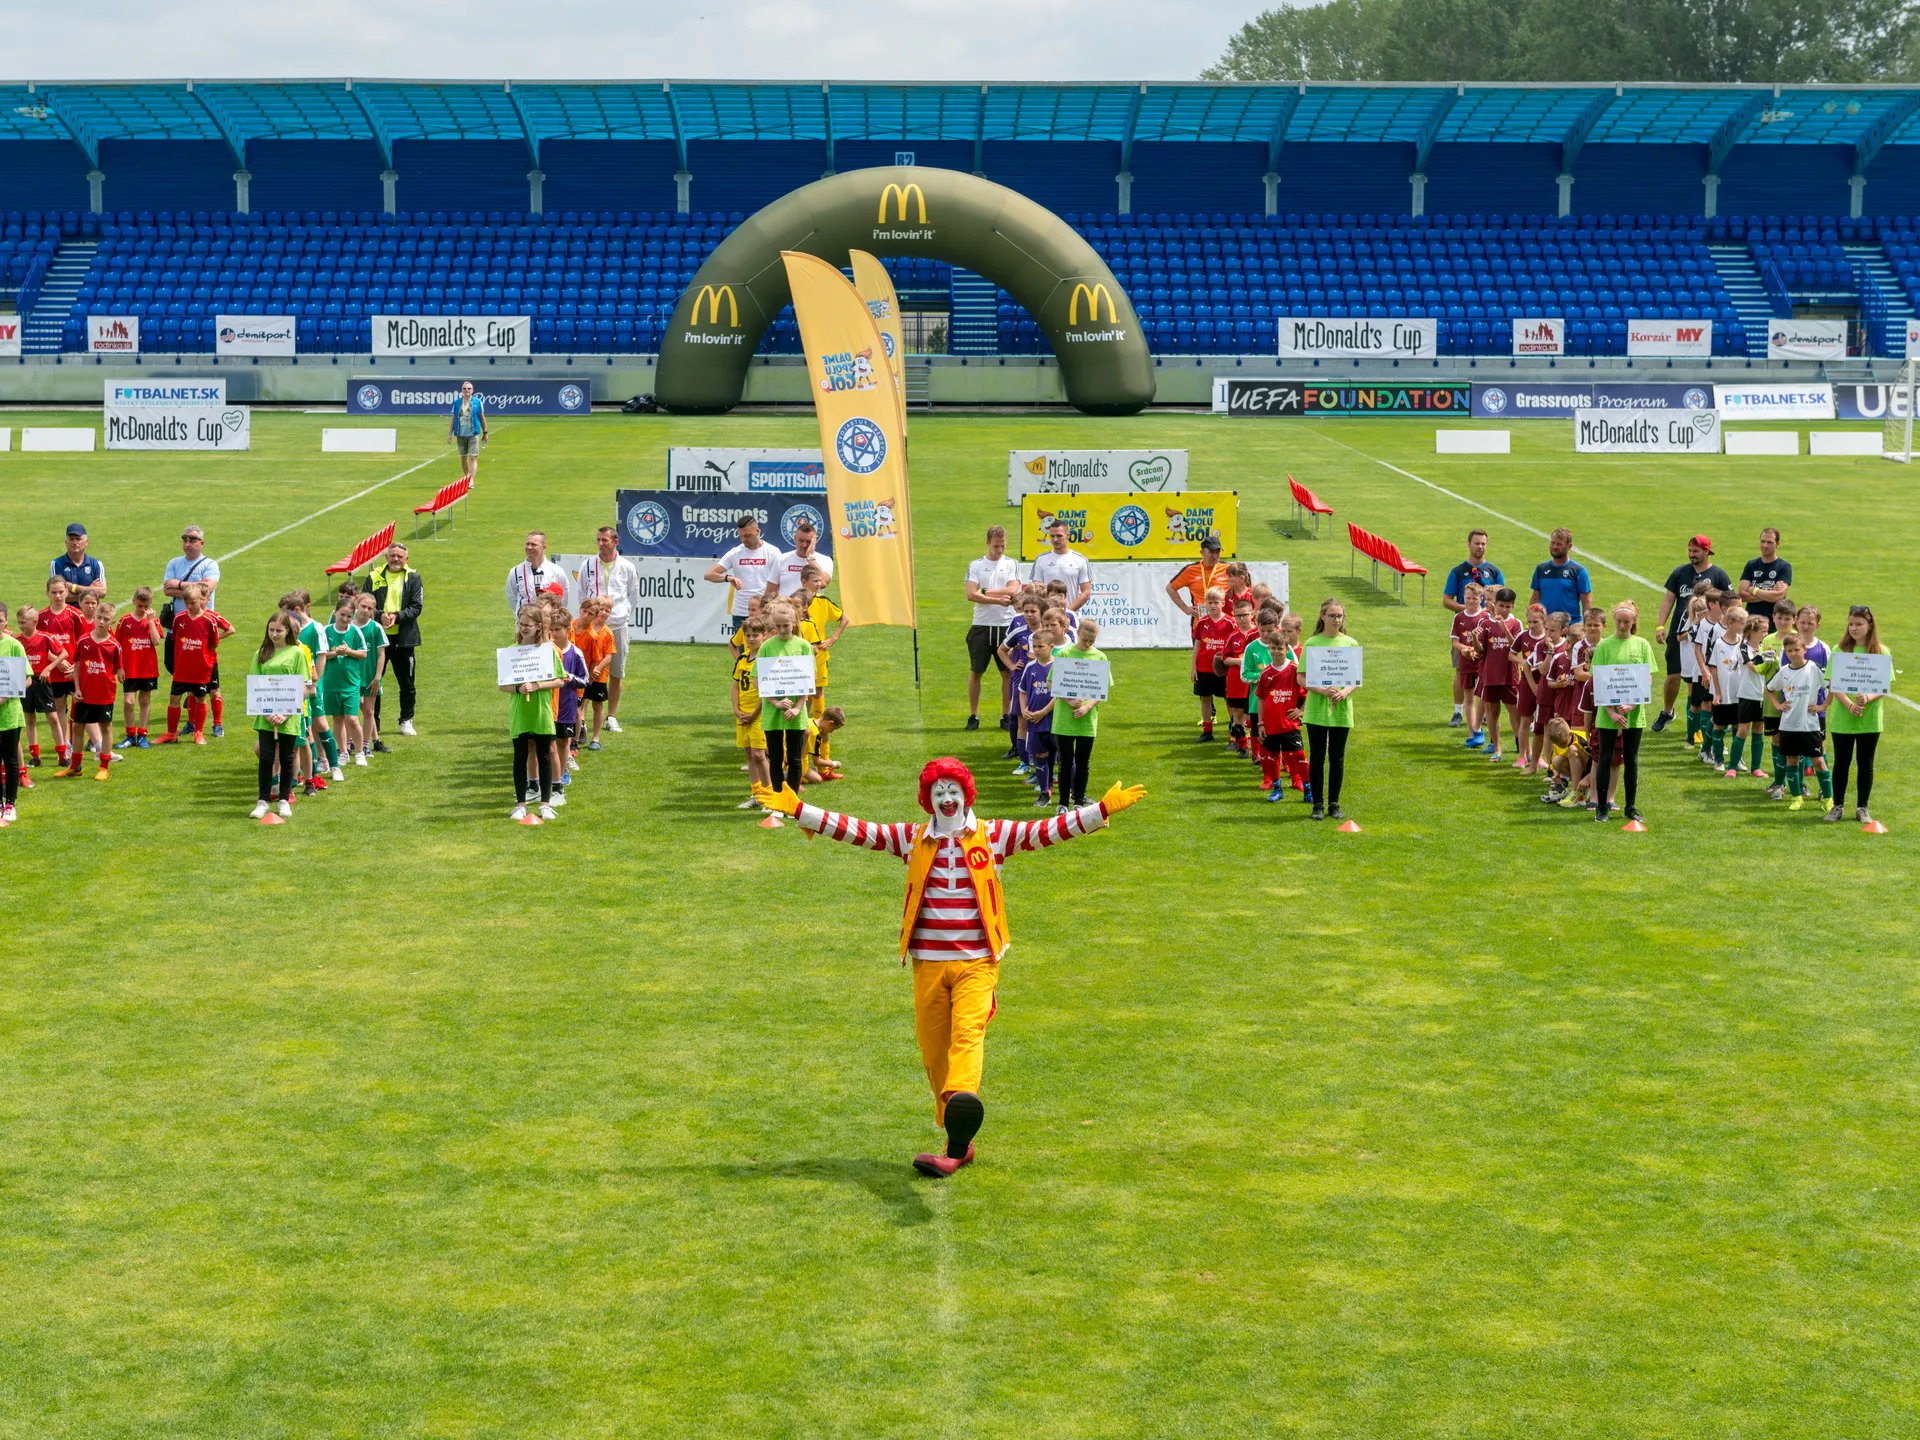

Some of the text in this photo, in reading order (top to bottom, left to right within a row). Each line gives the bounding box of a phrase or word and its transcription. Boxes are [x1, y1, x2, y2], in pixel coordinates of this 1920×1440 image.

[873, 229, 891, 240] i'm
[388, 319, 515, 353] McDonald's Cup
[684, 332, 701, 343] i'm
[1066, 332, 1083, 342] i'm
[1294, 322, 1422, 355] McDonald's Cup
[1631, 328, 1704, 342] Korzár MY
[1230, 387, 1301, 411] UEFA
[1304, 390, 1470, 409] FOUNDATION
[1516, 393, 1592, 408] Grassroots
[1599, 395, 1668, 409] Program
[1856, 385, 1920, 418] UE
[109, 416, 222, 446] McDonald's Cup
[1581, 419, 1694, 449] McDonald's Cup
[1049, 458, 1108, 479] McDonald's
[1136, 465, 1164, 476] Srdcom
[677, 475, 721, 490] PUMA
[1058, 510, 1086, 518] DAJME
[1186, 508, 1214, 516] DAJME
[1186, 517, 1213, 526] SPOLU
[1068, 527, 1086, 543] ÓL
[639, 569, 695, 599] onald's
[1103, 599, 1130, 607] VEDY,
[1111, 607, 1150, 615] ŠPORTU
[741, 670, 751, 691] 6
